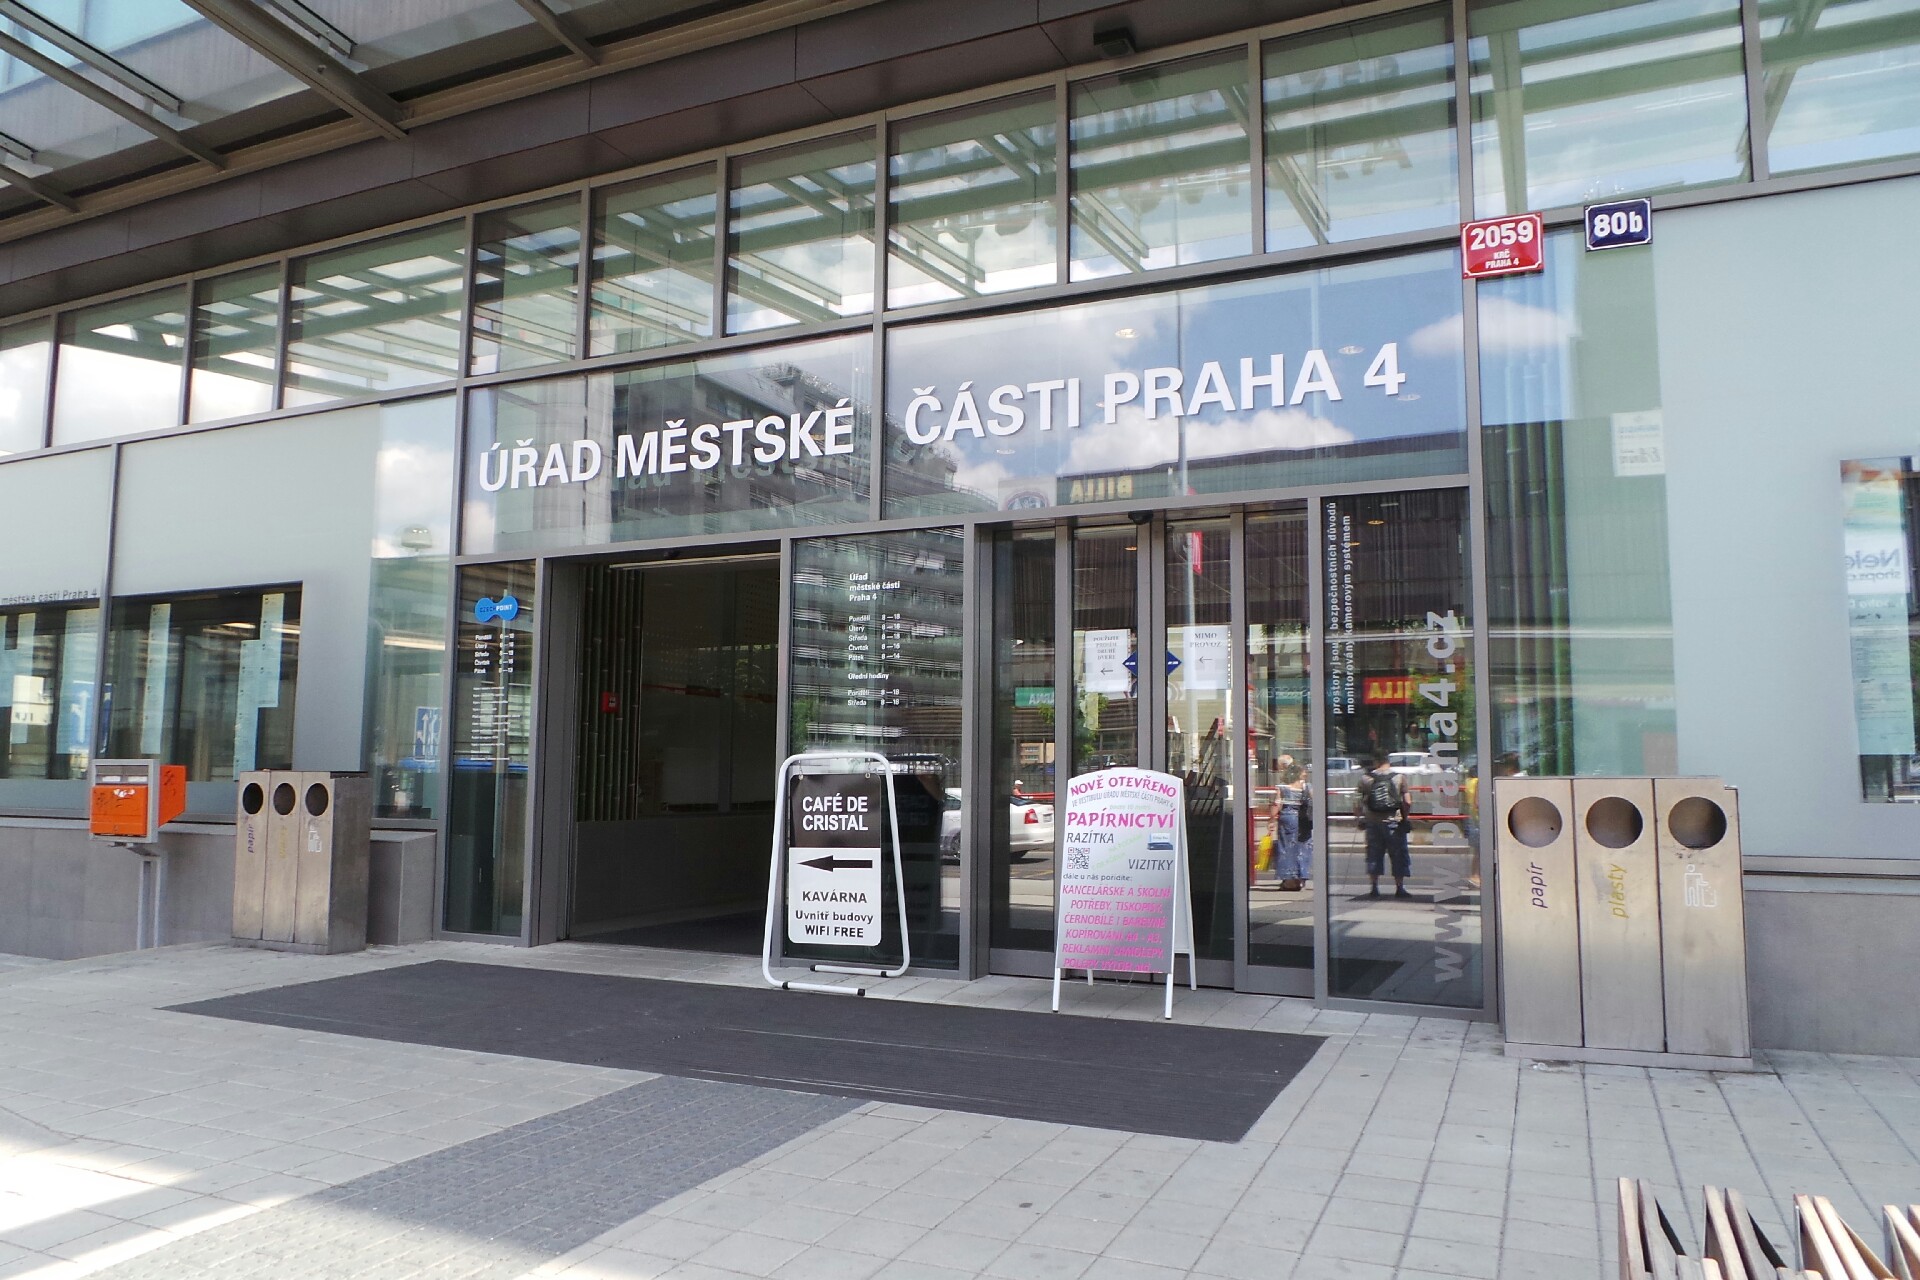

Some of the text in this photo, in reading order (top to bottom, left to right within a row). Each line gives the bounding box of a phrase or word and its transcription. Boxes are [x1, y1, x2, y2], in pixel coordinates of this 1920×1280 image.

[1593, 211, 1644, 238] 80b
[1470, 220, 1534, 251] 2059
[1485, 257, 1520, 269] PRAHA 4
[479, 437, 601, 493] ÚŘAD
[616, 398, 854, 478] MĚSTSKÉ
[904, 376, 1082, 445] ČÁSTI
[1102, 348, 1343, 425] PRAHA
[1362, 342, 1407, 396] 4
[1328, 502, 1337, 541] důvodů
[849, 572, 869, 581] Úřad
[849, 580, 900, 592] městské části
[1329, 544, 1340, 631] bezpečnostních
[849, 592, 877, 602] Praha 4
[1343, 515, 1356, 714] monitorovány kamerovým systémem
[1189, 640, 1223, 648] PROVOZ
[1332, 669, 1342, 714] prostory
[1108, 775, 1177, 798] OTEVŘENO
[802, 793, 868, 812] CAFÉ DE
[802, 814, 869, 831] CRISTAL
[1067, 807, 1176, 829] PAPÍRNICTVÍ
[1066, 830, 1114, 844] RAZÍTKA
[1128, 859, 1173, 871] VIZITKY
[1127, 887, 1134, 897] A
[1527, 862, 1548, 908] papír
[1607, 863, 1630, 919] plasty
[802, 889, 867, 904] KAVÁRNA
[795, 910, 874, 925] Uvnitř budovy
[804, 924, 864, 938] WIFI FREE
